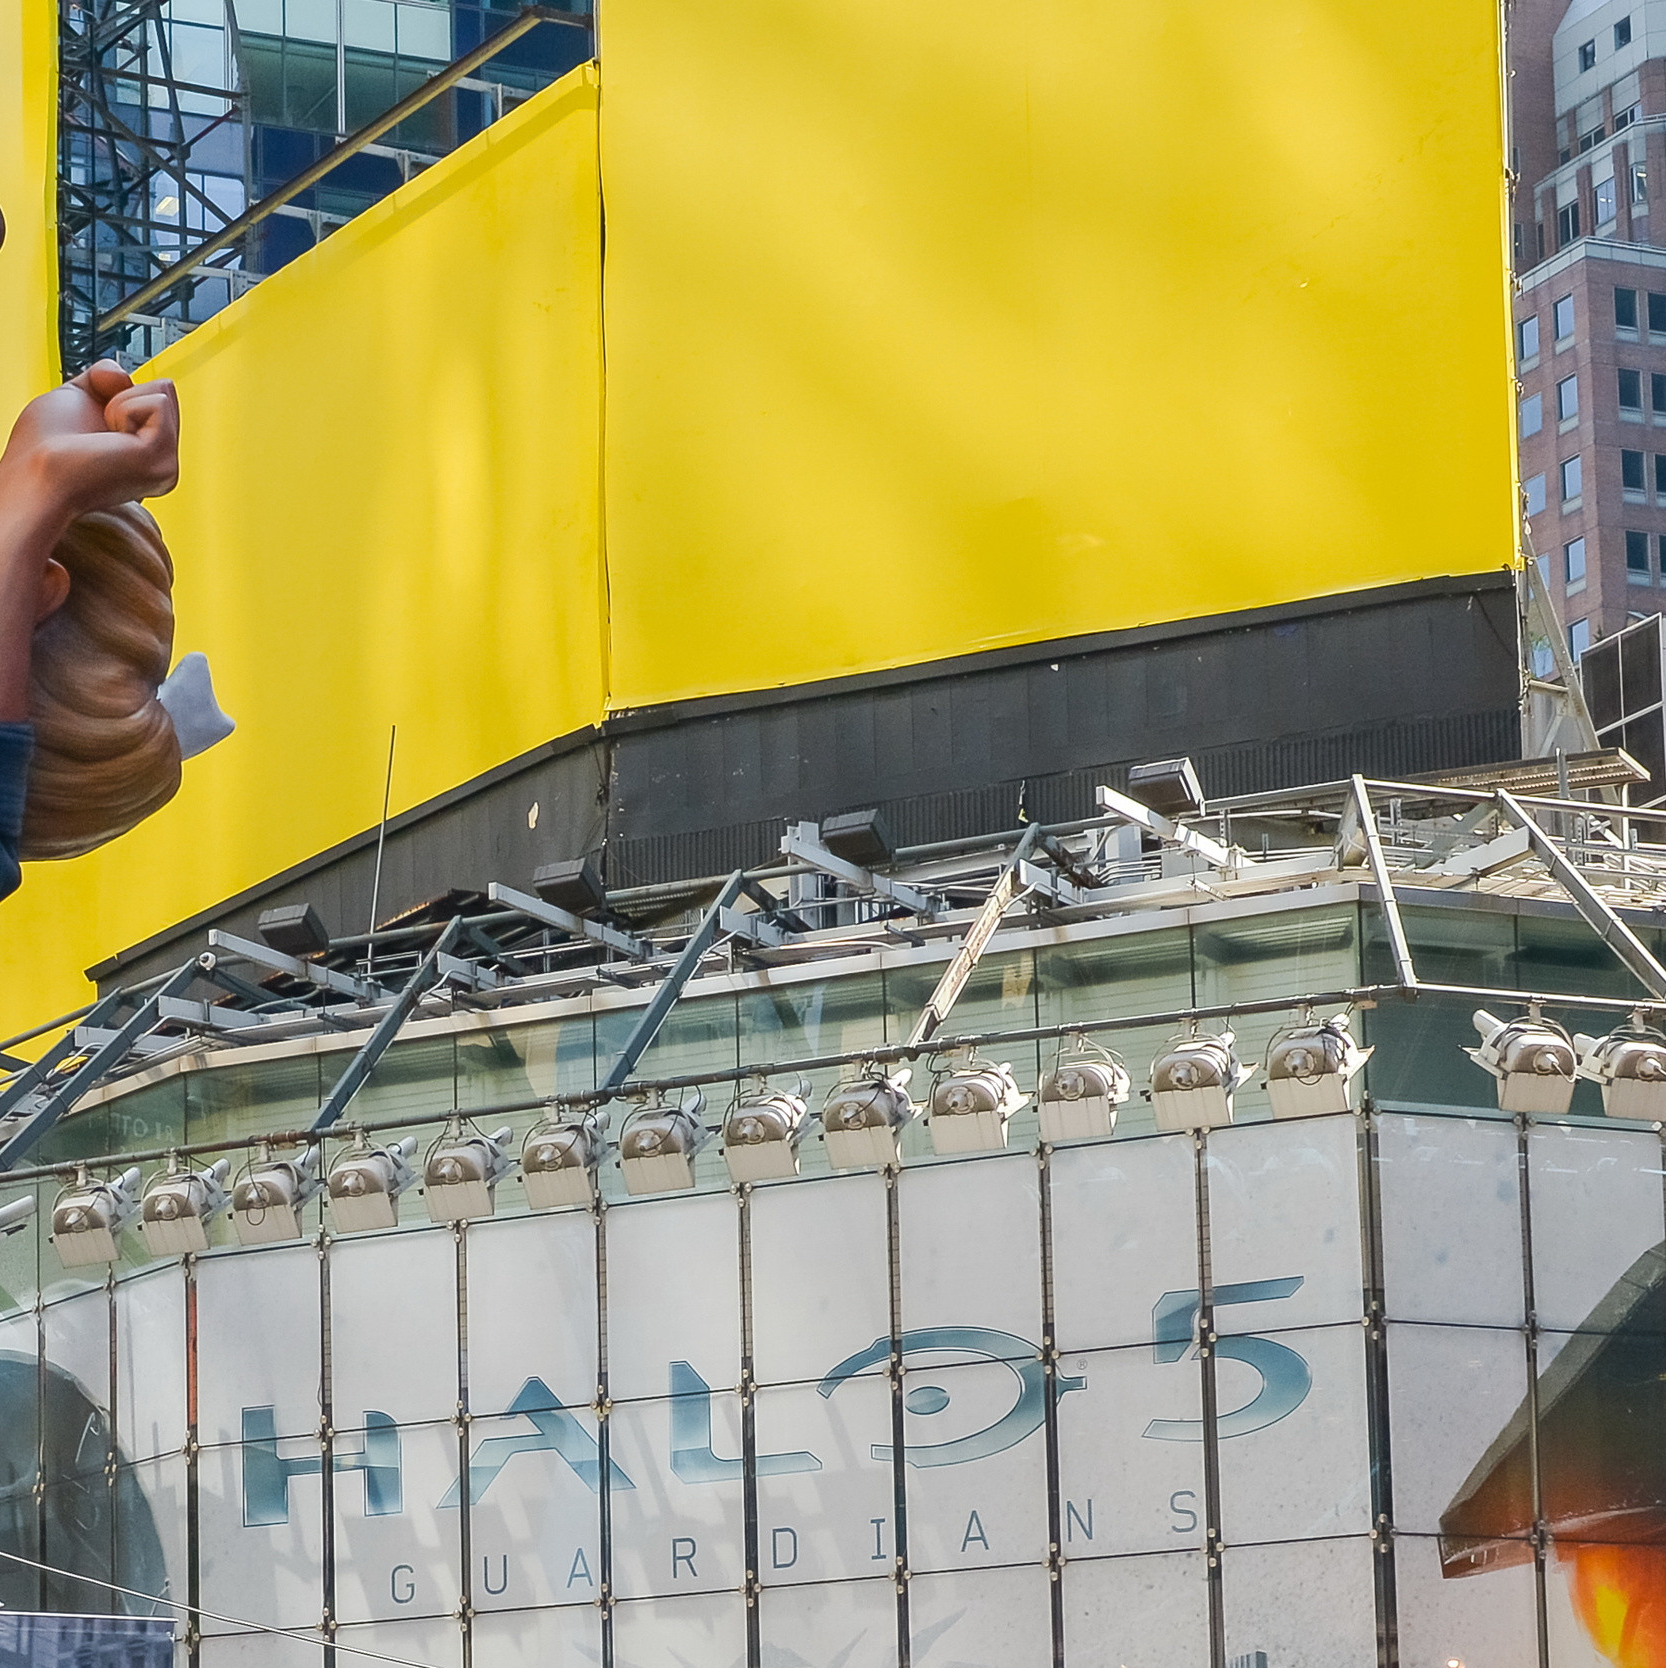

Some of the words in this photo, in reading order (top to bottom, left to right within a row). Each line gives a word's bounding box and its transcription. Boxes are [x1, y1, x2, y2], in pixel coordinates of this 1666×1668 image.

[239, 1324, 1088, 1527] HALO
[1141, 1275, 1312, 1443] 5
[391, 1489, 1198, 1605] GUARDIANS
